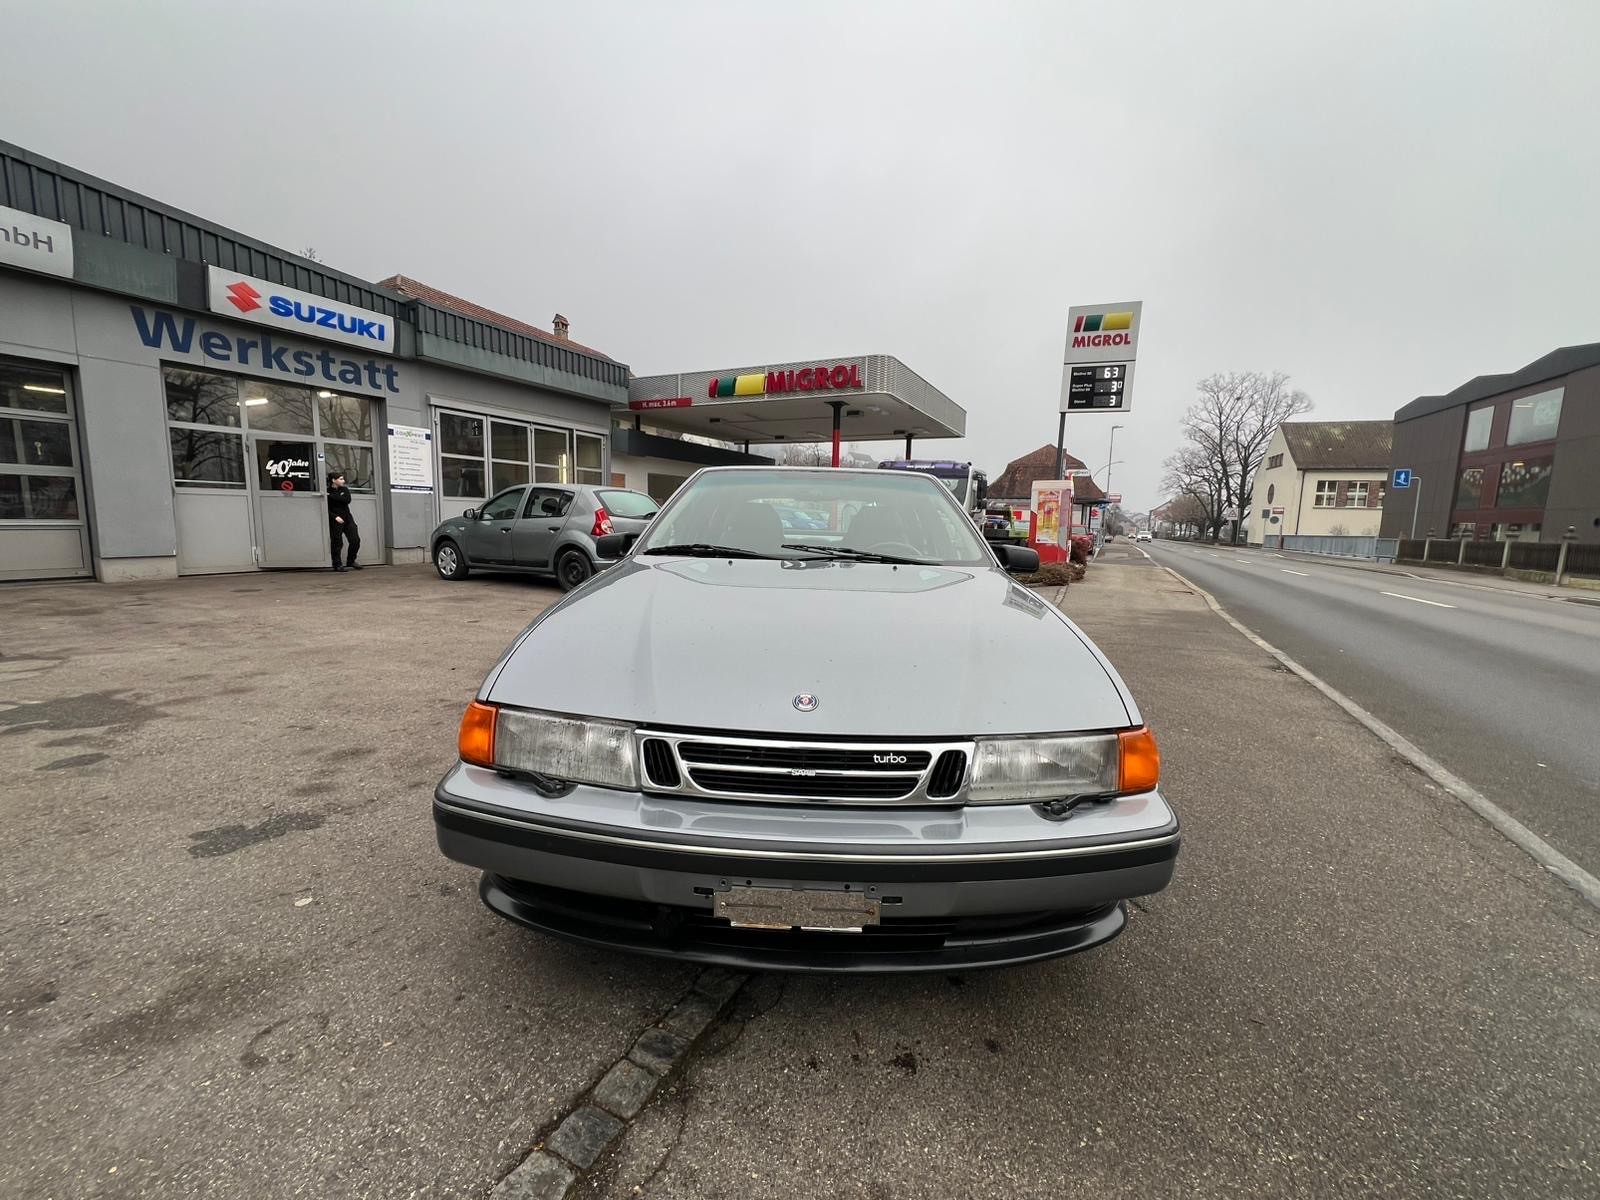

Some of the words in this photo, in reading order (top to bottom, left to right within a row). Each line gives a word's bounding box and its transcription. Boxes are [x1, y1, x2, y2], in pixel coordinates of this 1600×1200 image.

[269, 295, 385, 342] SUZUKI
[129, 305, 400, 393] Werkstatt
[1072, 333, 1131, 348] MIGROL
[766, 364, 862, 394] MIGROL
[265, 459, 290, 475] 40
[287, 458, 309, 467] Jahre
[873, 753, 907, 764] turbo
